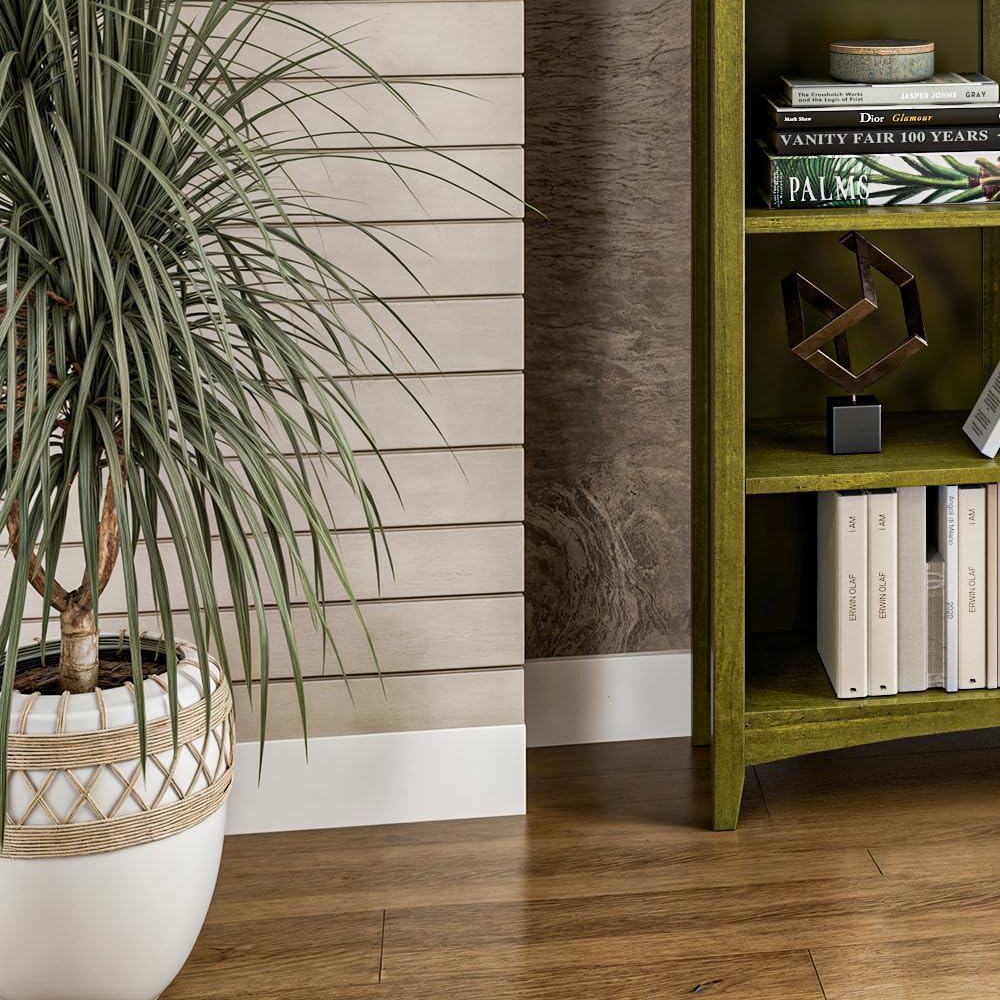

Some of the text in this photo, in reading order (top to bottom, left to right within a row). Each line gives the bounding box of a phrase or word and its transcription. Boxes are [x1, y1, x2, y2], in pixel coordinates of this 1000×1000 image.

[900, 92, 929, 100] JASPER
[859, 112, 934, 123] Dior Glamour
[779, 130, 988, 146] VANITY FAIR 100 YEARS
[789, 174, 870, 202] PALMS
[878, 513, 886, 526] AM
[968, 508, 976, 521] AM
[849, 516, 857, 529] AM
[878, 572, 886, 619] ERWIN OLAF
[968, 566, 976, 613] ERWIN OLAF
[849, 574, 857, 621] ERWIN OLAF
